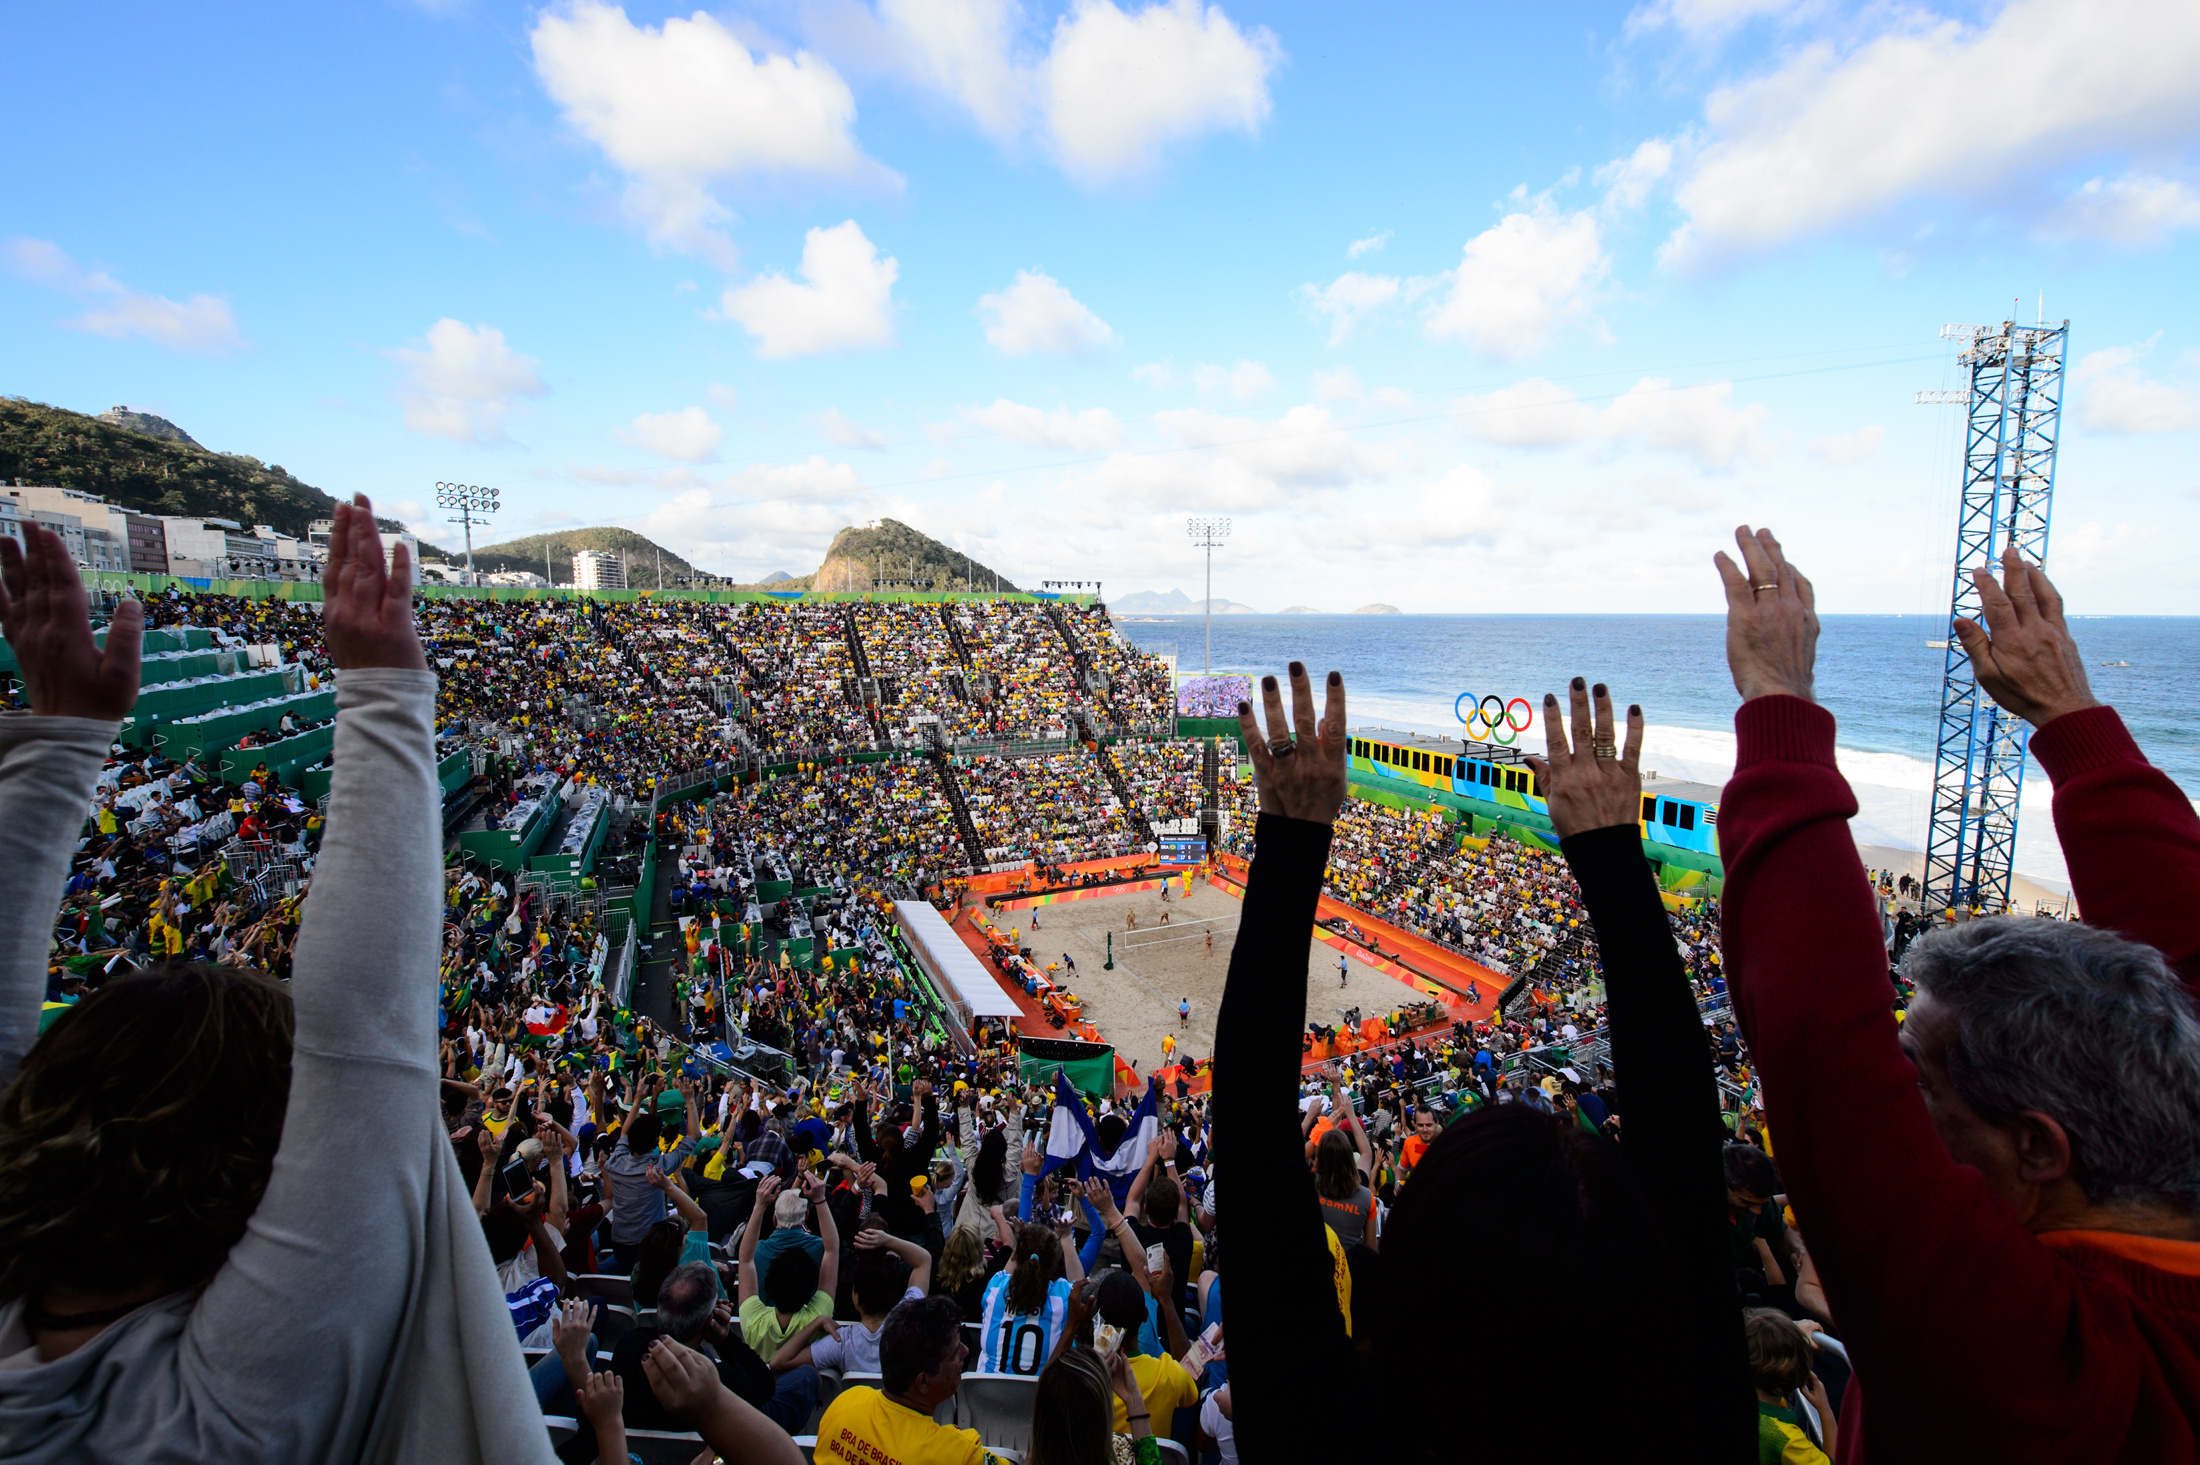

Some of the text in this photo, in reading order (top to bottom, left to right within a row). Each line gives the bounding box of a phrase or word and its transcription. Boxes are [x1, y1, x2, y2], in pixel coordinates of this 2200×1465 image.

[1319, 1197, 1360, 1215] eamNL
[999, 1321, 1044, 1376] 10
[830, 1439, 858, 1465] BRA DE
[840, 1428, 857, 1447] BRA
[857, 1439, 871, 1455] DE
